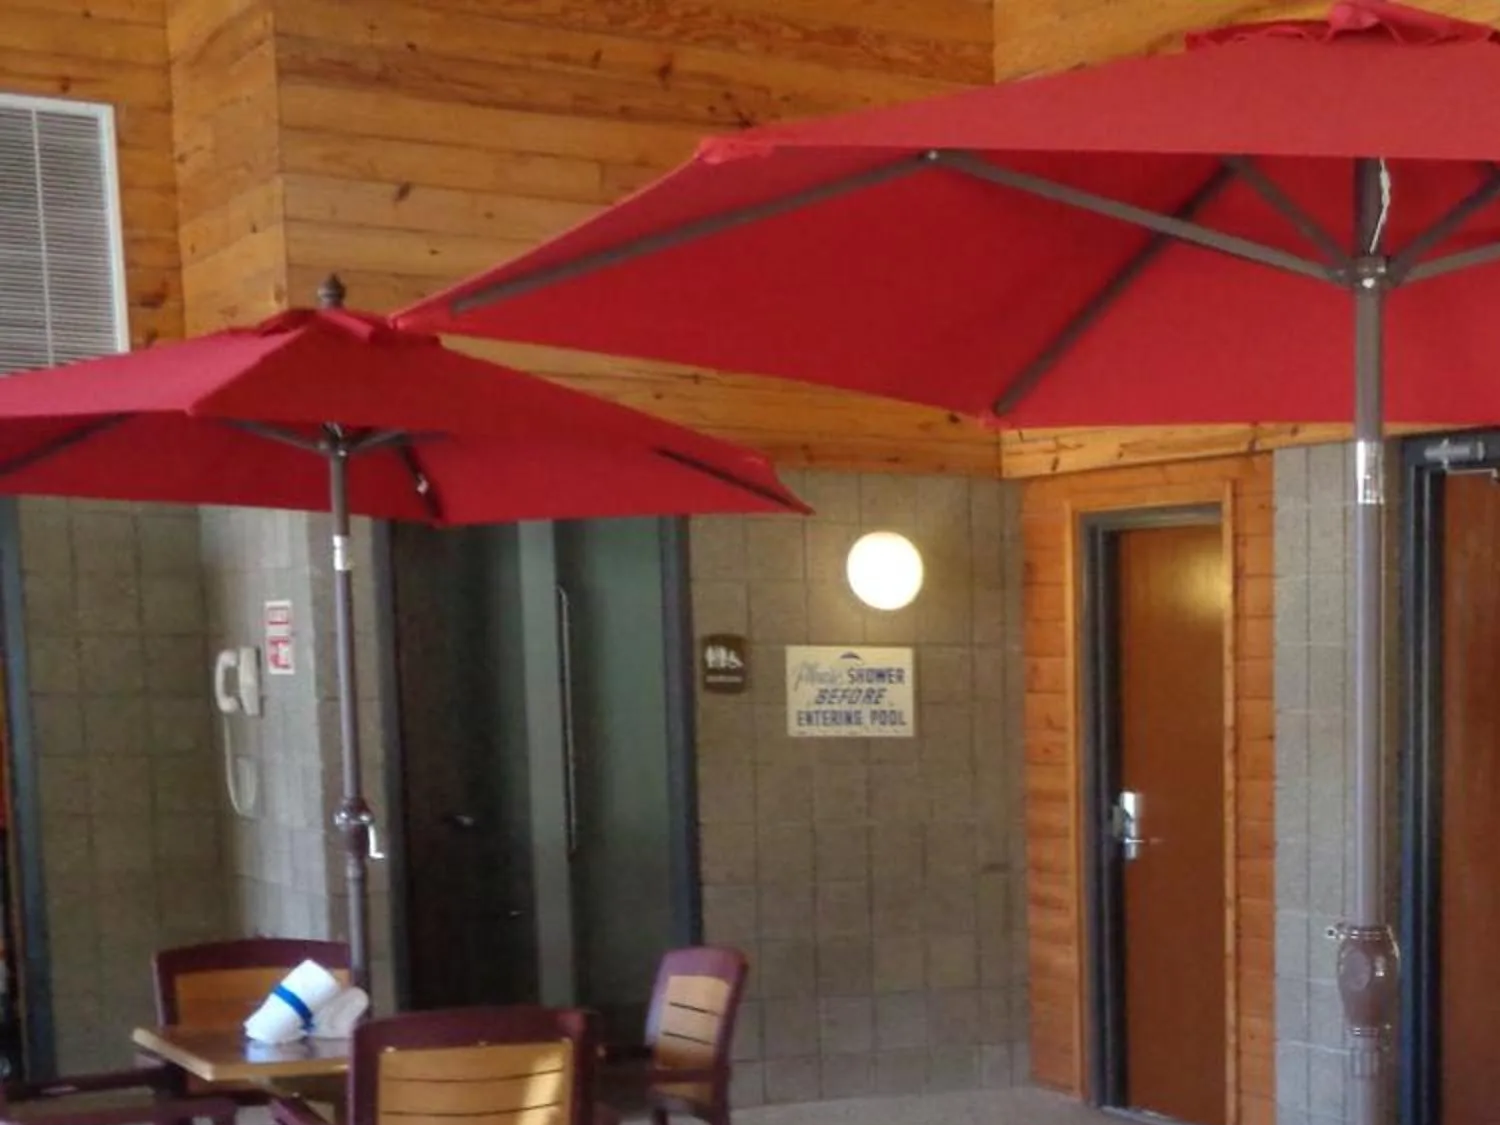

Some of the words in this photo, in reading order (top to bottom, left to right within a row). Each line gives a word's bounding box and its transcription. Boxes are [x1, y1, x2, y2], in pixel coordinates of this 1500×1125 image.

[847, 667, 905, 685] SHOWER
[815, 688, 887, 705] BEFORE
[797, 710, 863, 727] ENTERING
[870, 710, 908, 727] POOL
